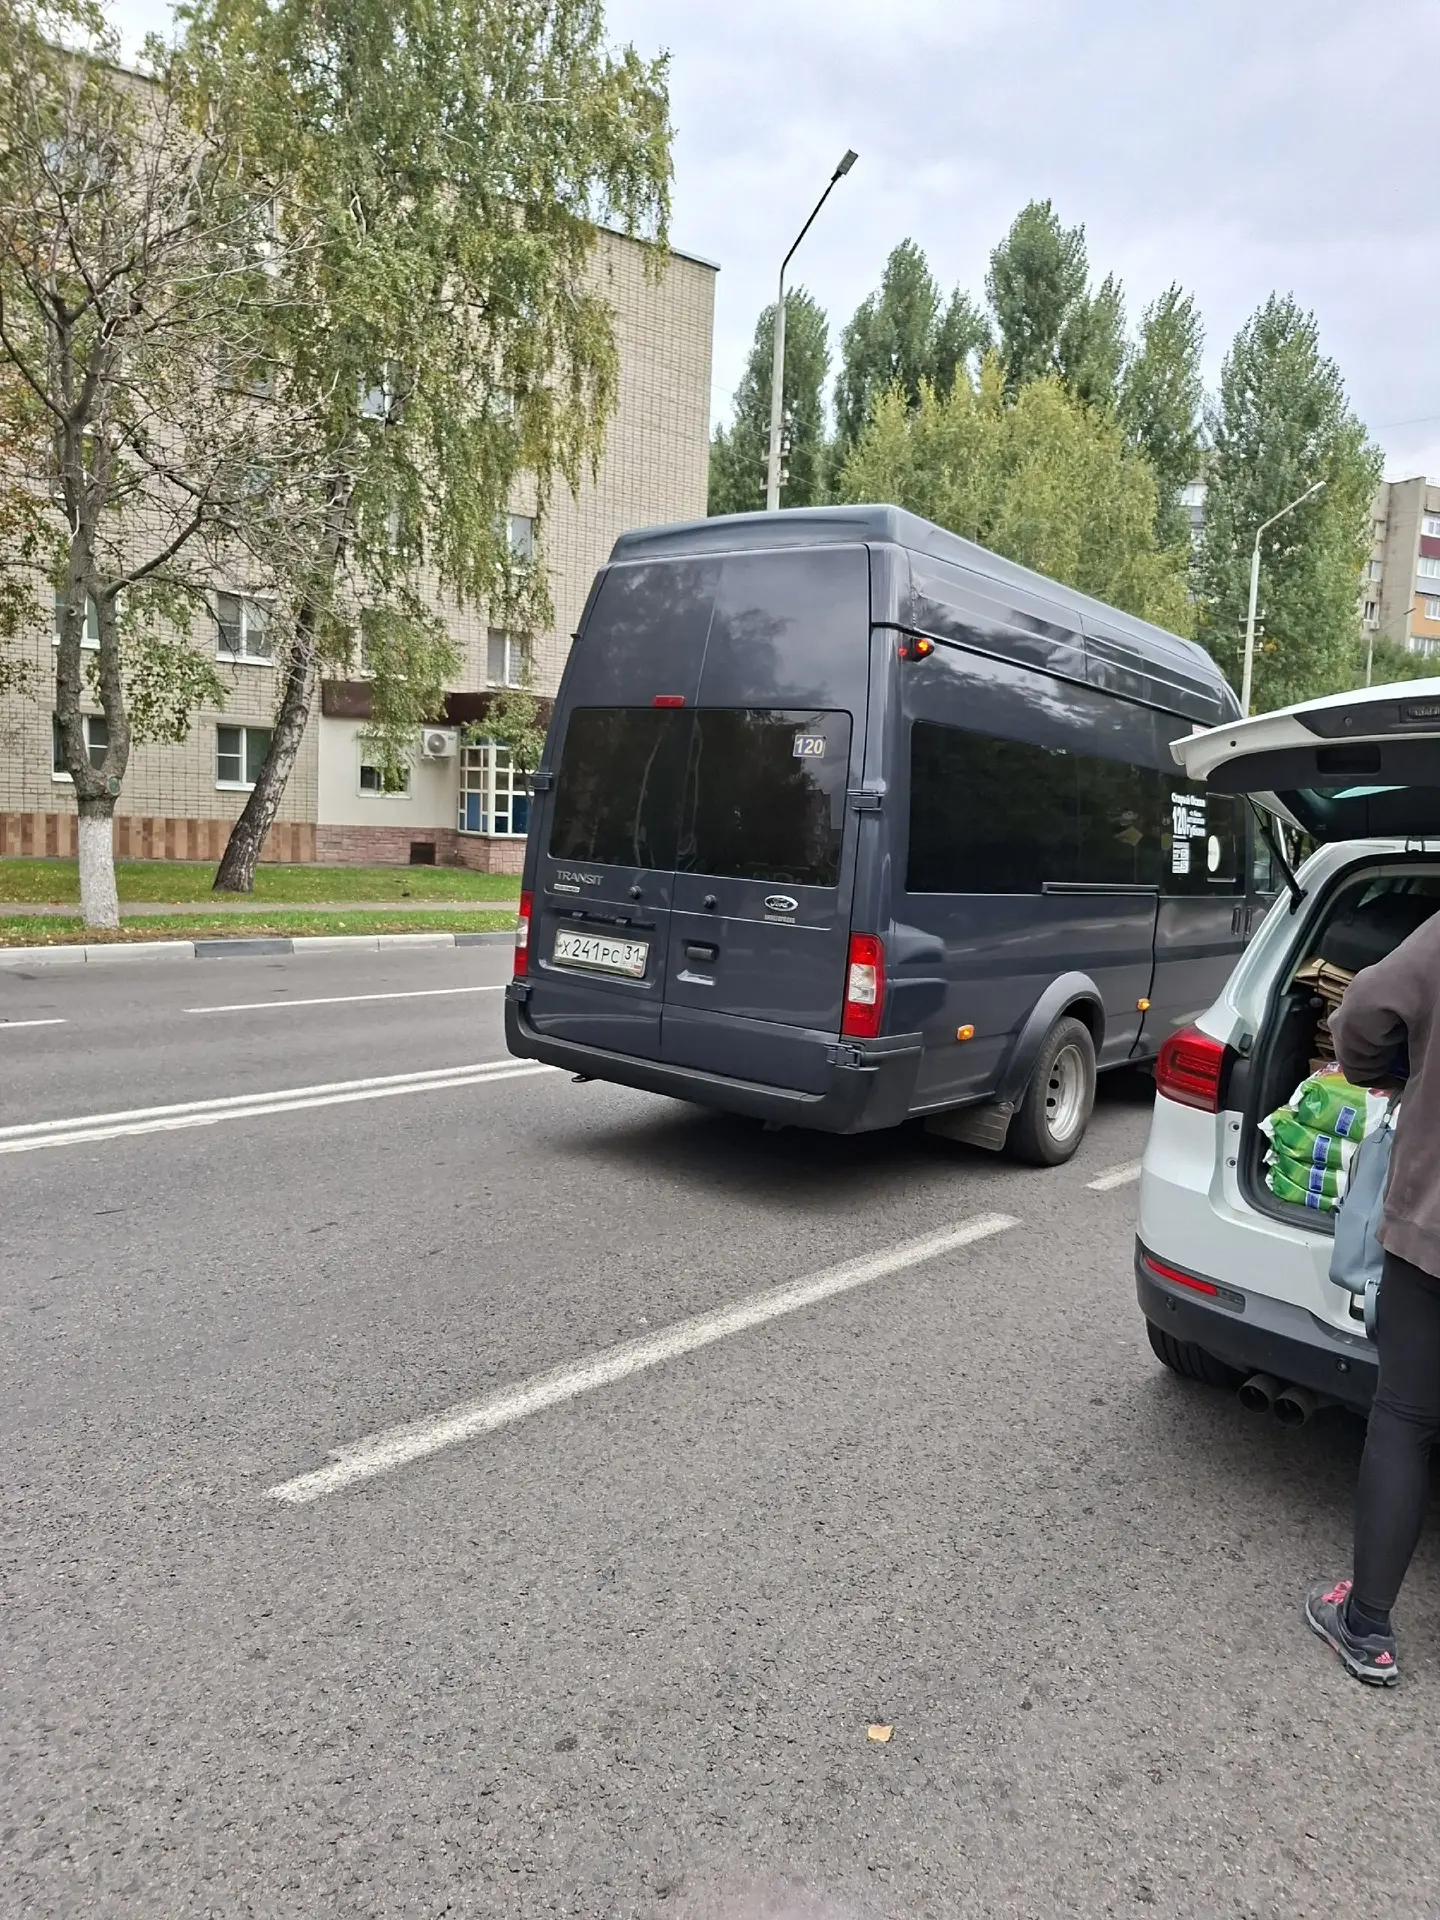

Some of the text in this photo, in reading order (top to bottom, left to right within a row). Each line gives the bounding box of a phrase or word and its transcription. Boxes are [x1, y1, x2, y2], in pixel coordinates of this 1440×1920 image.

[796, 738, 824, 754] 120
[1172, 806, 1187, 835] 120
[557, 870, 604, 886] TRANSIT
[624, 945, 641, 962] 31
